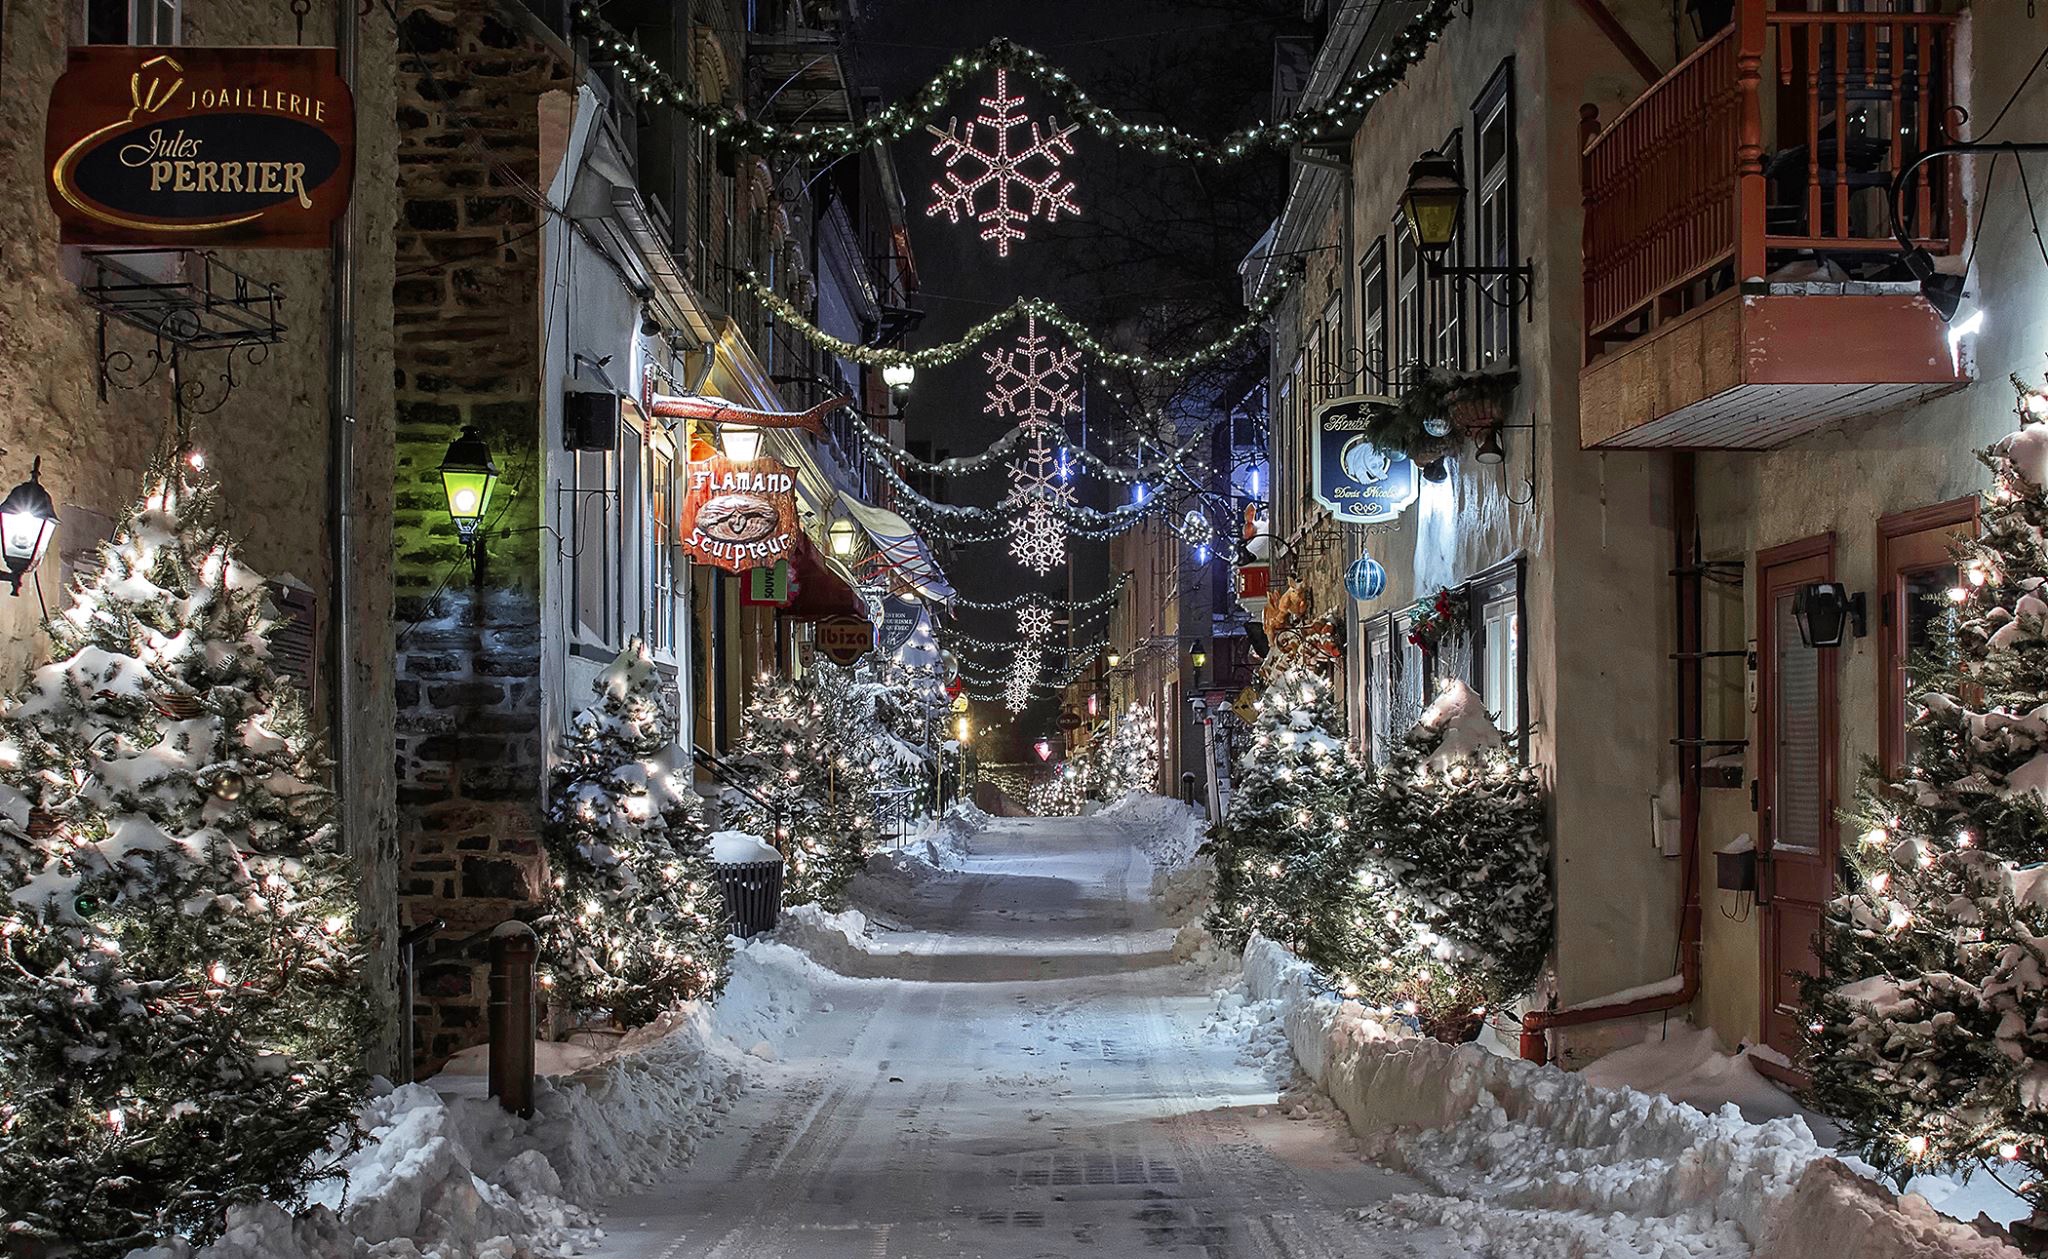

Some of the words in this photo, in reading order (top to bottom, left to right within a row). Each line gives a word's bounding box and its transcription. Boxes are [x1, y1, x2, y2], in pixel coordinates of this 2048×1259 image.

[187, 88, 326, 123] JOAILLERIE
[119, 129, 203, 168] Jules
[150, 160, 313, 209] PERRIER
[691, 471, 793, 493] FLAMAND
[1334, 485, 1361, 498] Denis
[684, 526, 790, 569] Sculpteur
[821, 628, 868, 645] Ibiza
